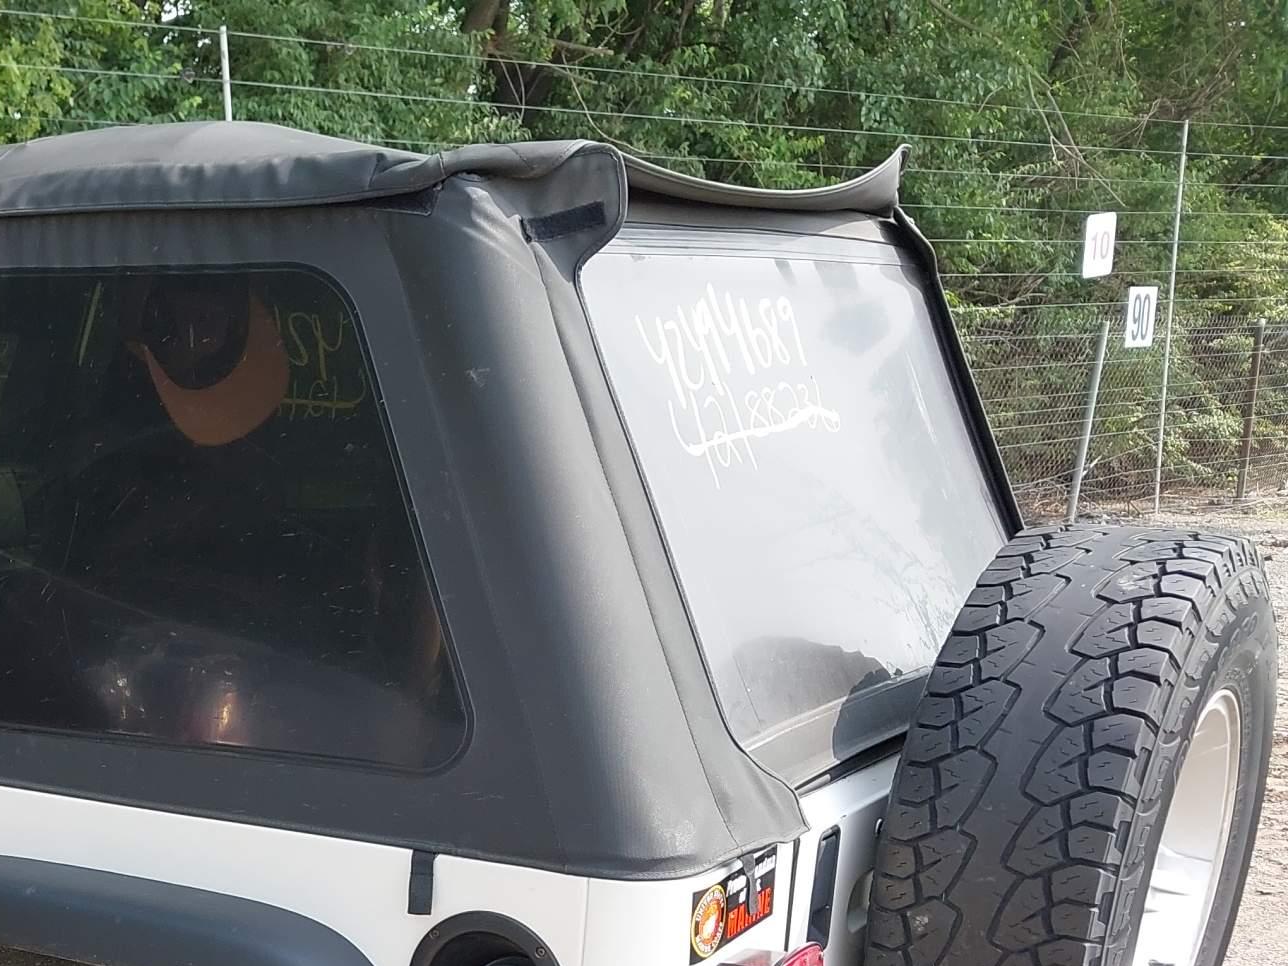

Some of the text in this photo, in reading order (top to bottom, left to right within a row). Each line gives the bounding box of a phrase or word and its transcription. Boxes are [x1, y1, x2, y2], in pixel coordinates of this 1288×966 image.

[1091, 230, 1111, 261] 10
[1131, 292, 1151, 342] 90
[634, 281, 808, 410] 42494689
